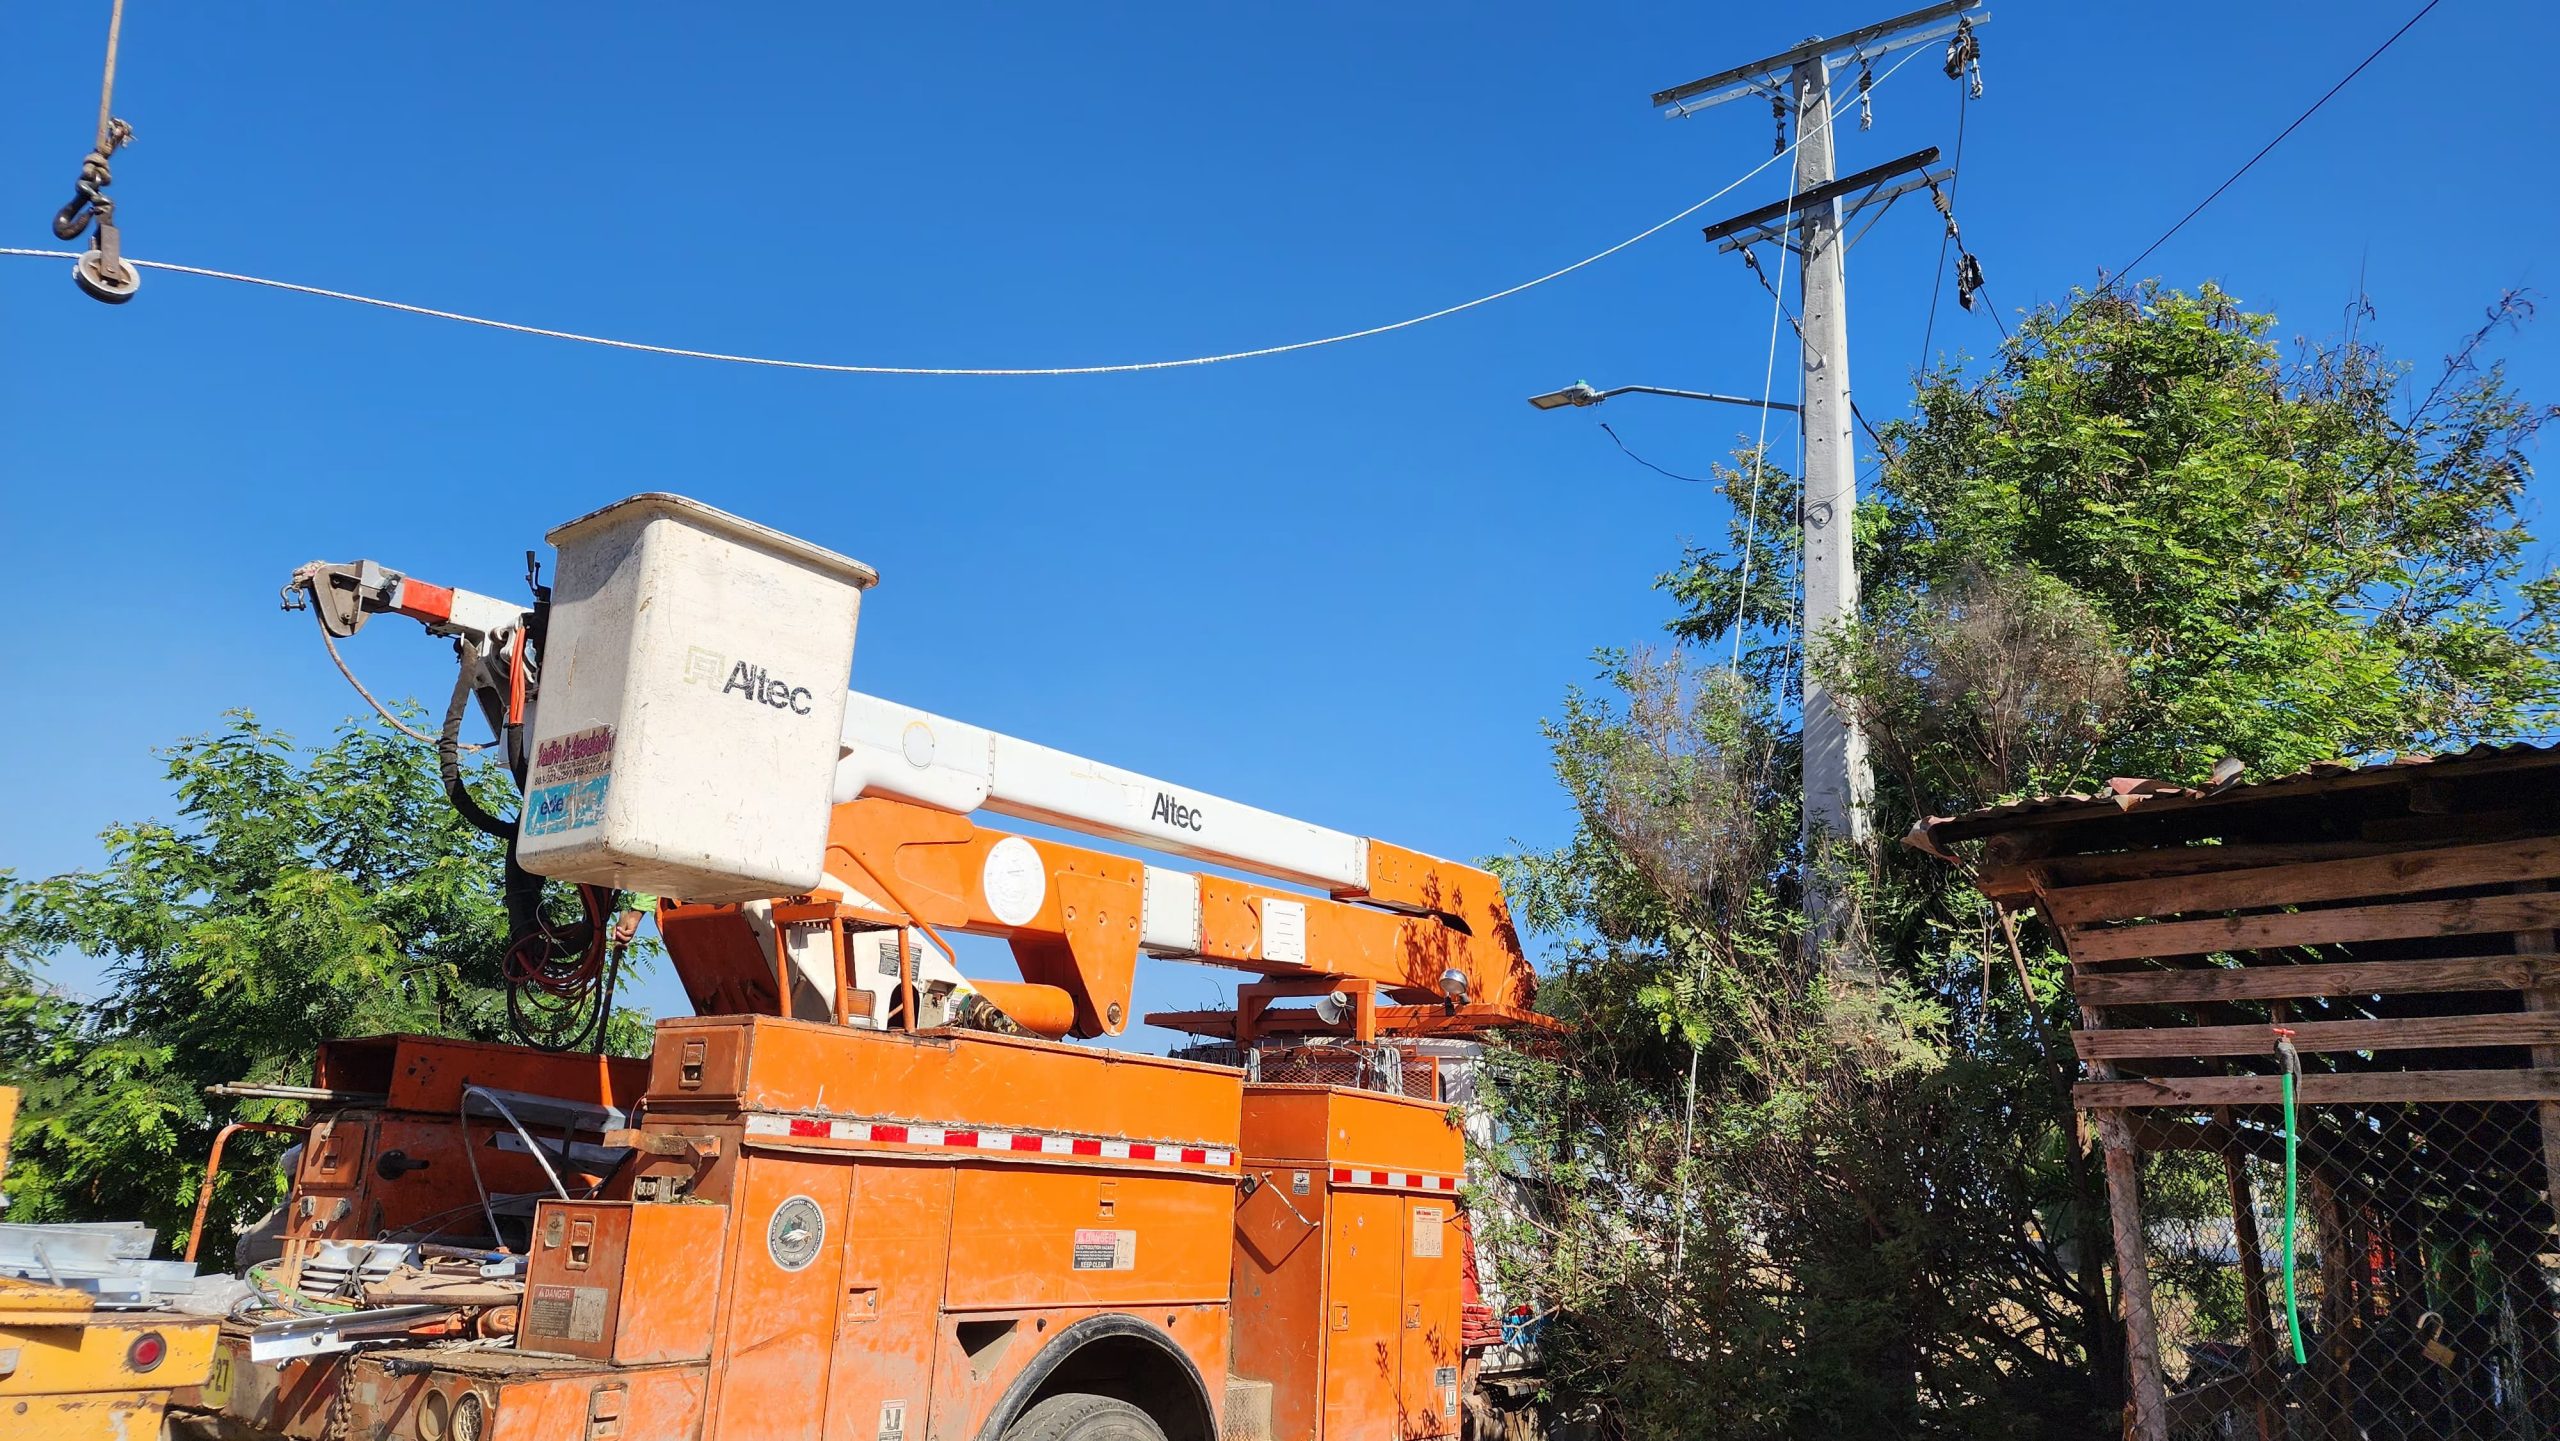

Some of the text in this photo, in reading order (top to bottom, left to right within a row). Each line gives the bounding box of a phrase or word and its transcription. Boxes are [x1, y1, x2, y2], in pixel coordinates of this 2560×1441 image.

[722, 660, 813, 717] Altec
[1151, 792, 1203, 832] Altec
[1086, 1232, 1114, 1243] DANGER
[544, 1288, 571, 1299] DANGER
